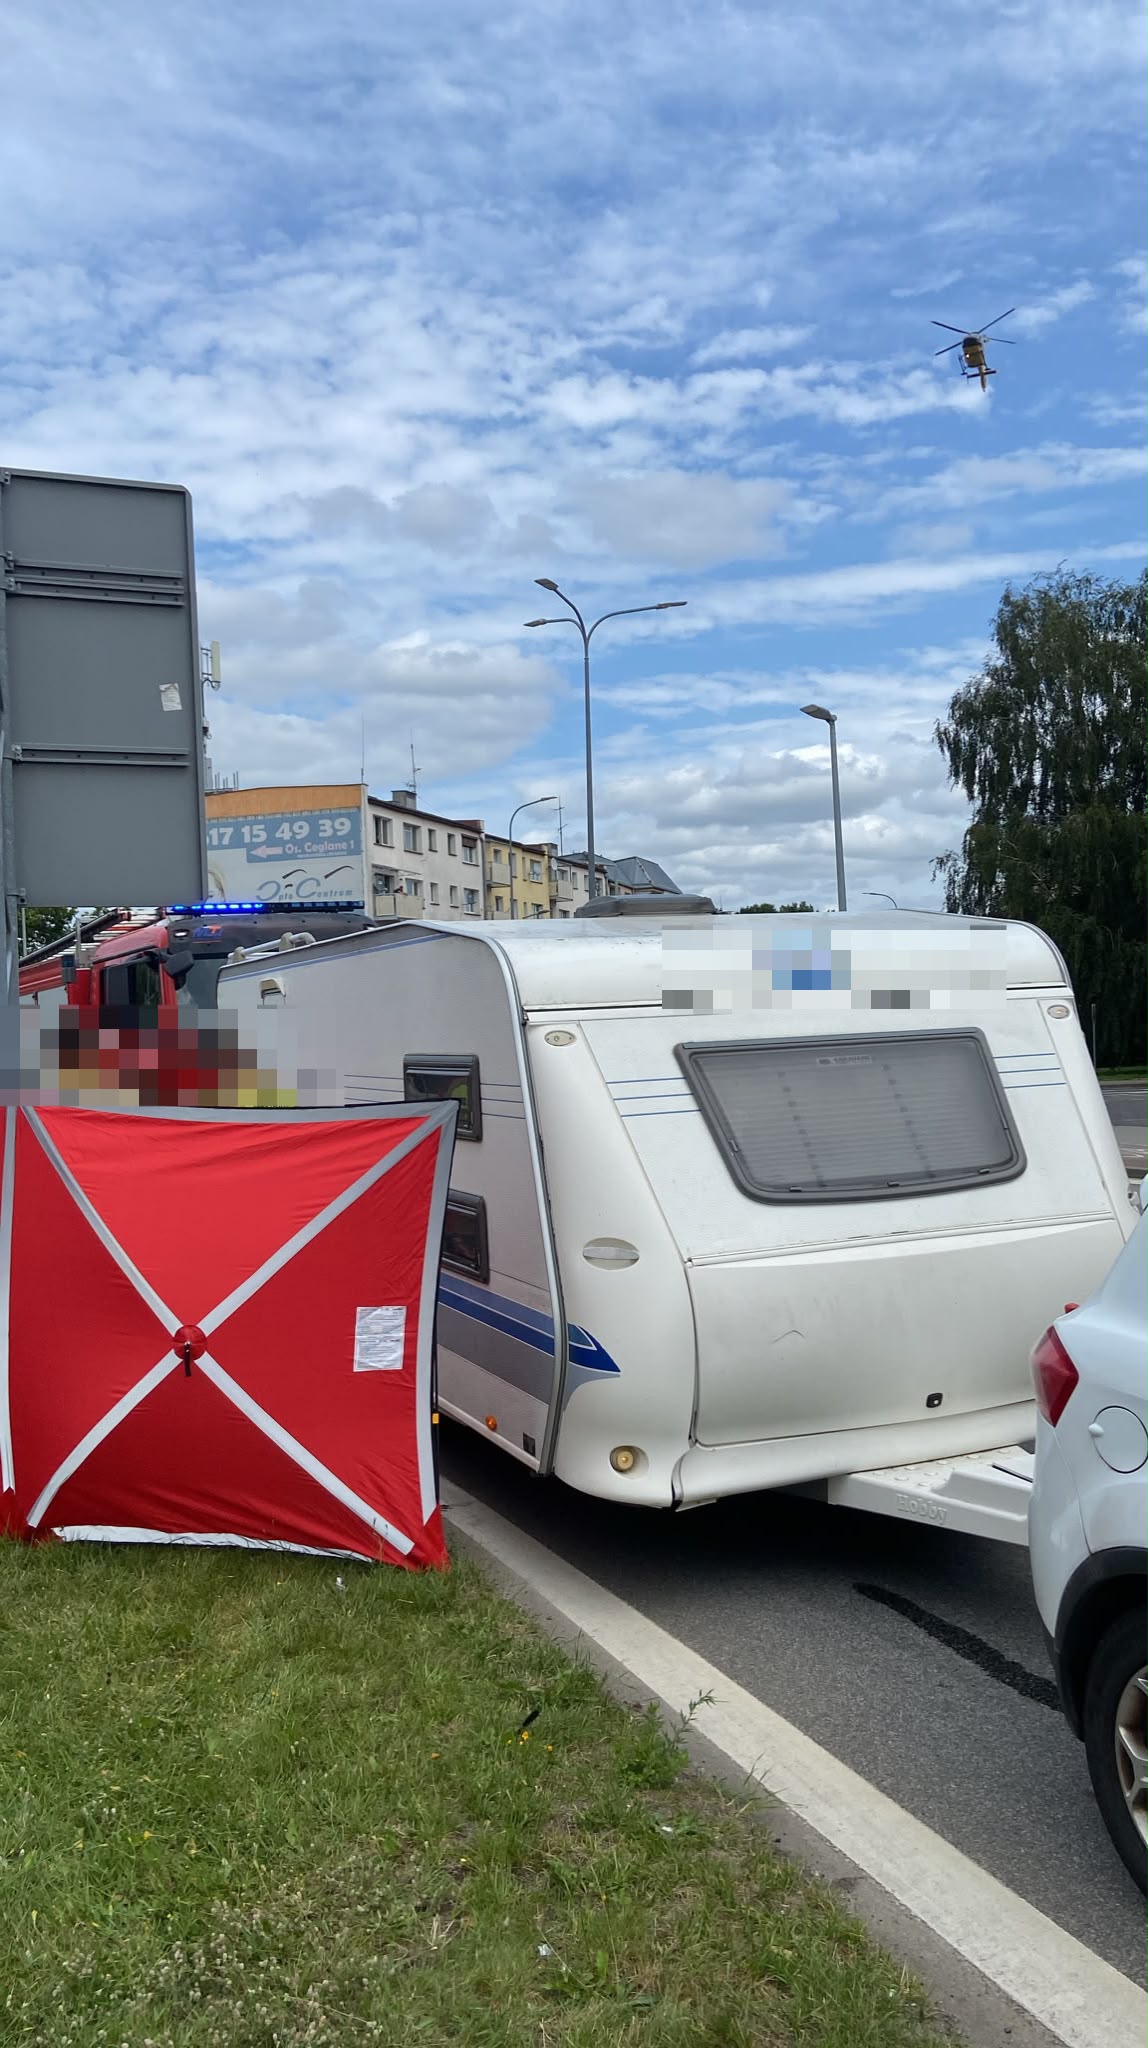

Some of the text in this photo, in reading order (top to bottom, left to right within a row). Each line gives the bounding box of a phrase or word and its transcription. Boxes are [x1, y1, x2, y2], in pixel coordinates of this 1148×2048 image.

[207, 817, 352, 846] 17 15 49 39
[349, 840, 355, 849] 1
[296, 877, 353, 899] Centrum
